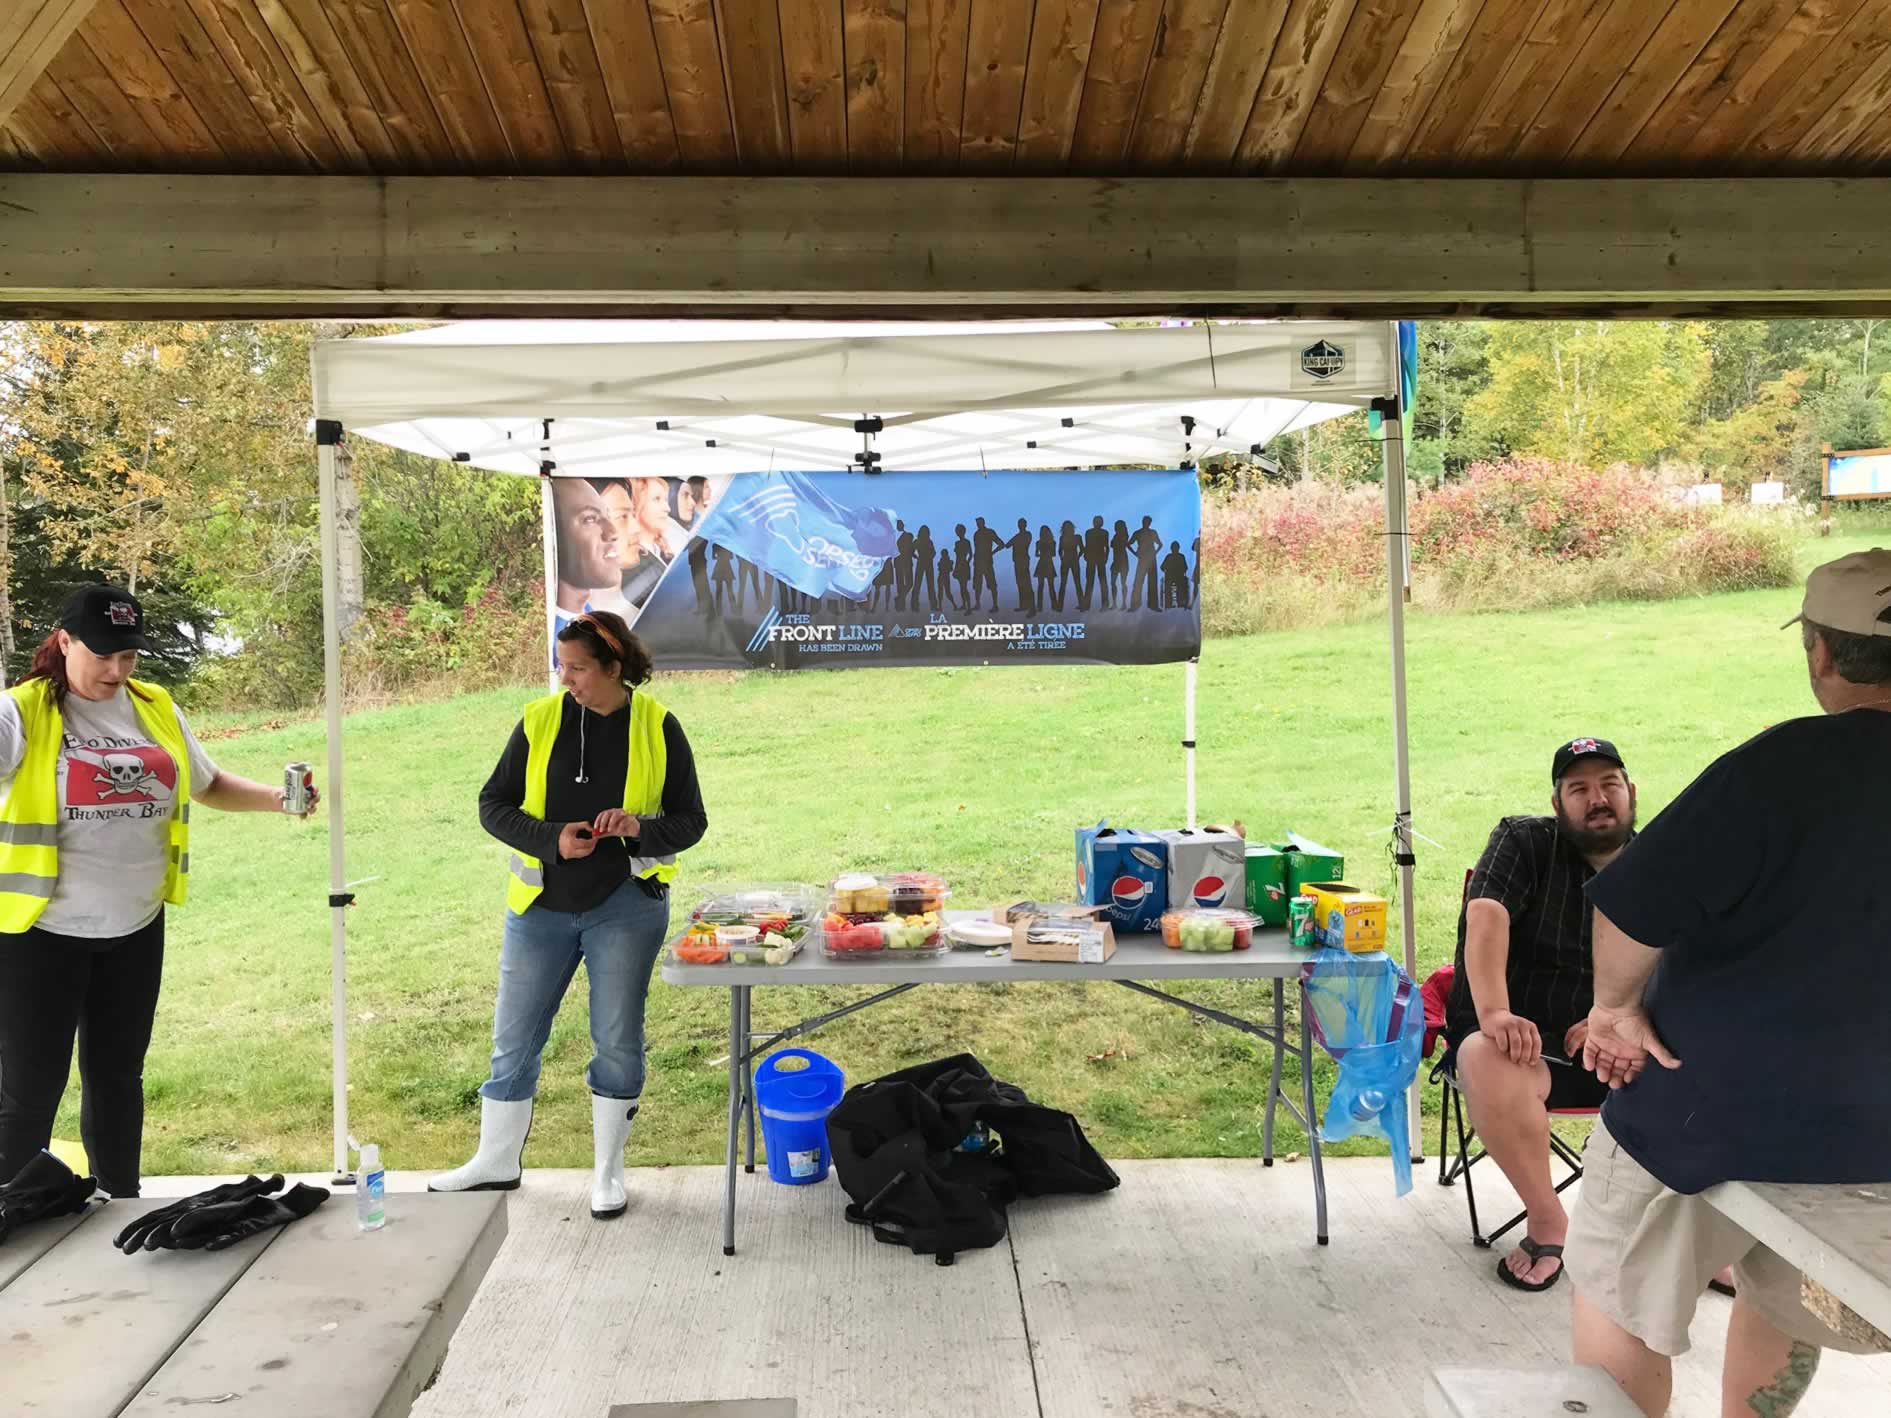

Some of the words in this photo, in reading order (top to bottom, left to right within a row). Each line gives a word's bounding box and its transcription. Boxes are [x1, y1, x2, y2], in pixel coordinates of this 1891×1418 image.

[785, 614, 811, 625] THE
[929, 613, 948, 624] LA
[767, 625, 837, 642] FRONT
[838, 624, 884, 641] LINE
[924, 618, 1025, 641] PREMIÈRE
[1026, 623, 1086, 640] LIGNE
[799, 643, 819, 653] HAS
[820, 643, 847, 653] BEEN
[849, 643, 884, 652] DRAWN
[64, 805, 135, 821] THUNDER
[138, 801, 169, 819] BAY
[1143, 917, 1160, 931] 24
